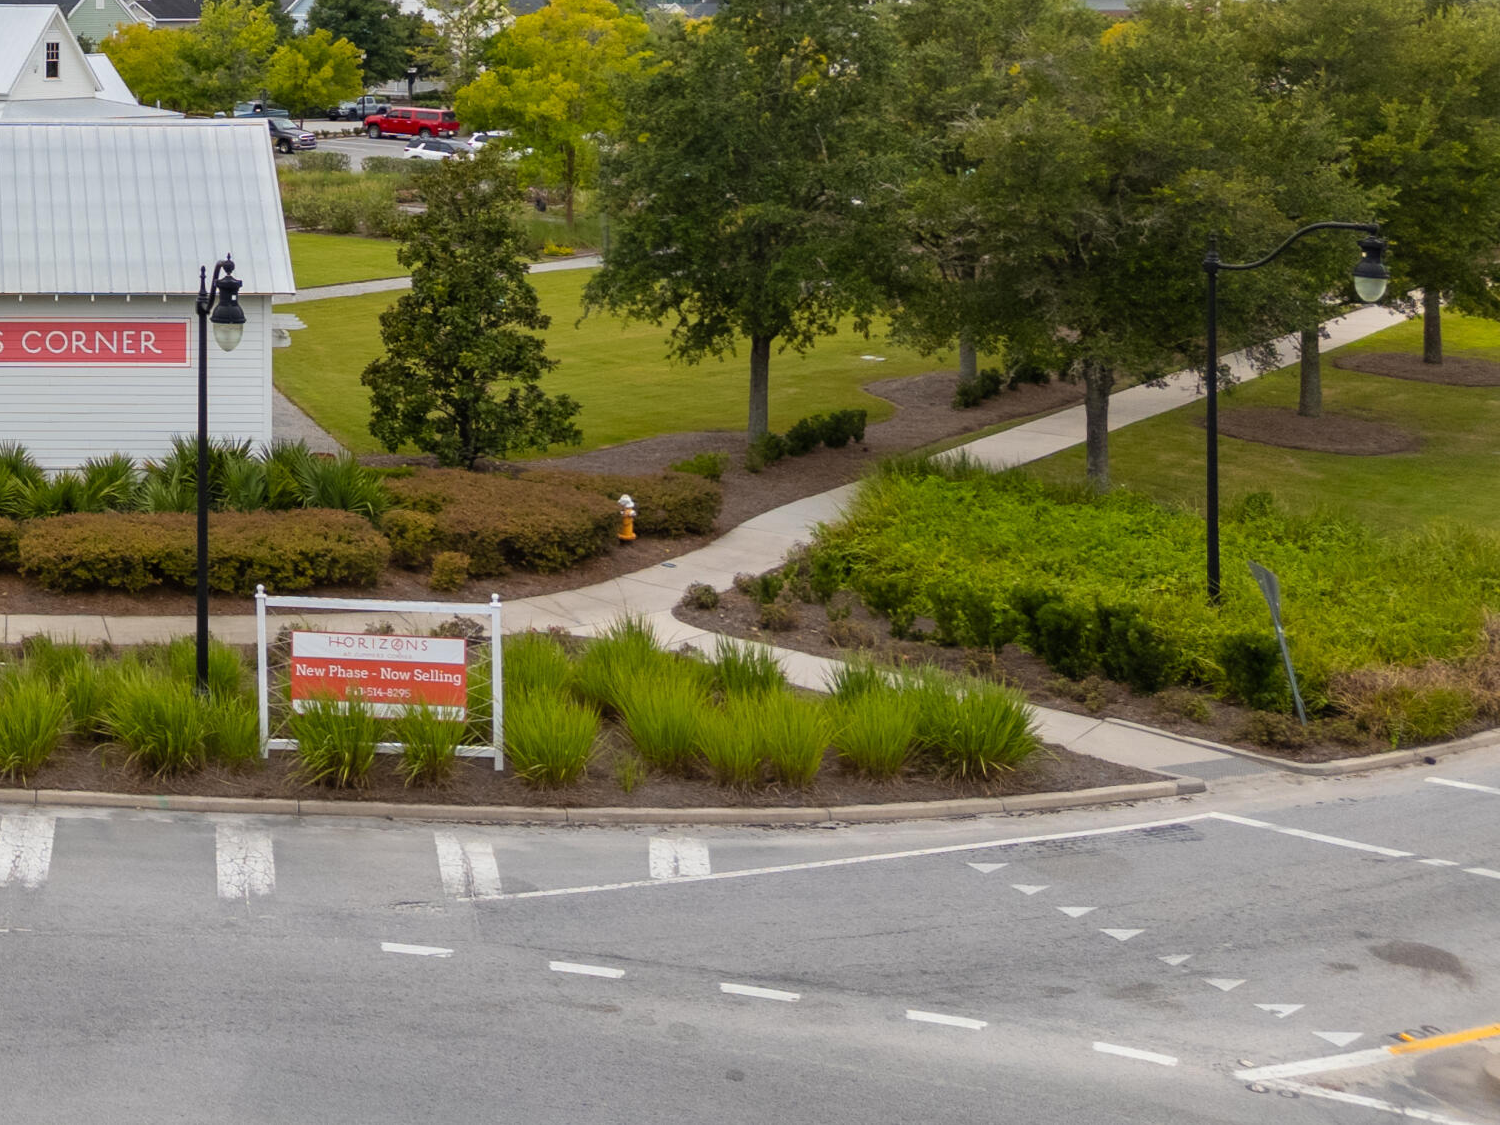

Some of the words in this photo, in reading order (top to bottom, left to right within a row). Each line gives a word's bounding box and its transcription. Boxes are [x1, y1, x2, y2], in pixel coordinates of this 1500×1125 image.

[22, 331, 162, 354] CORNER
[329, 636, 428, 652] HORIZONS
[296, 664, 325, 677] New
[329, 665, 368, 679] Phase
[380, 667, 410, 681] Now
[413, 669, 462, 685] Selling
